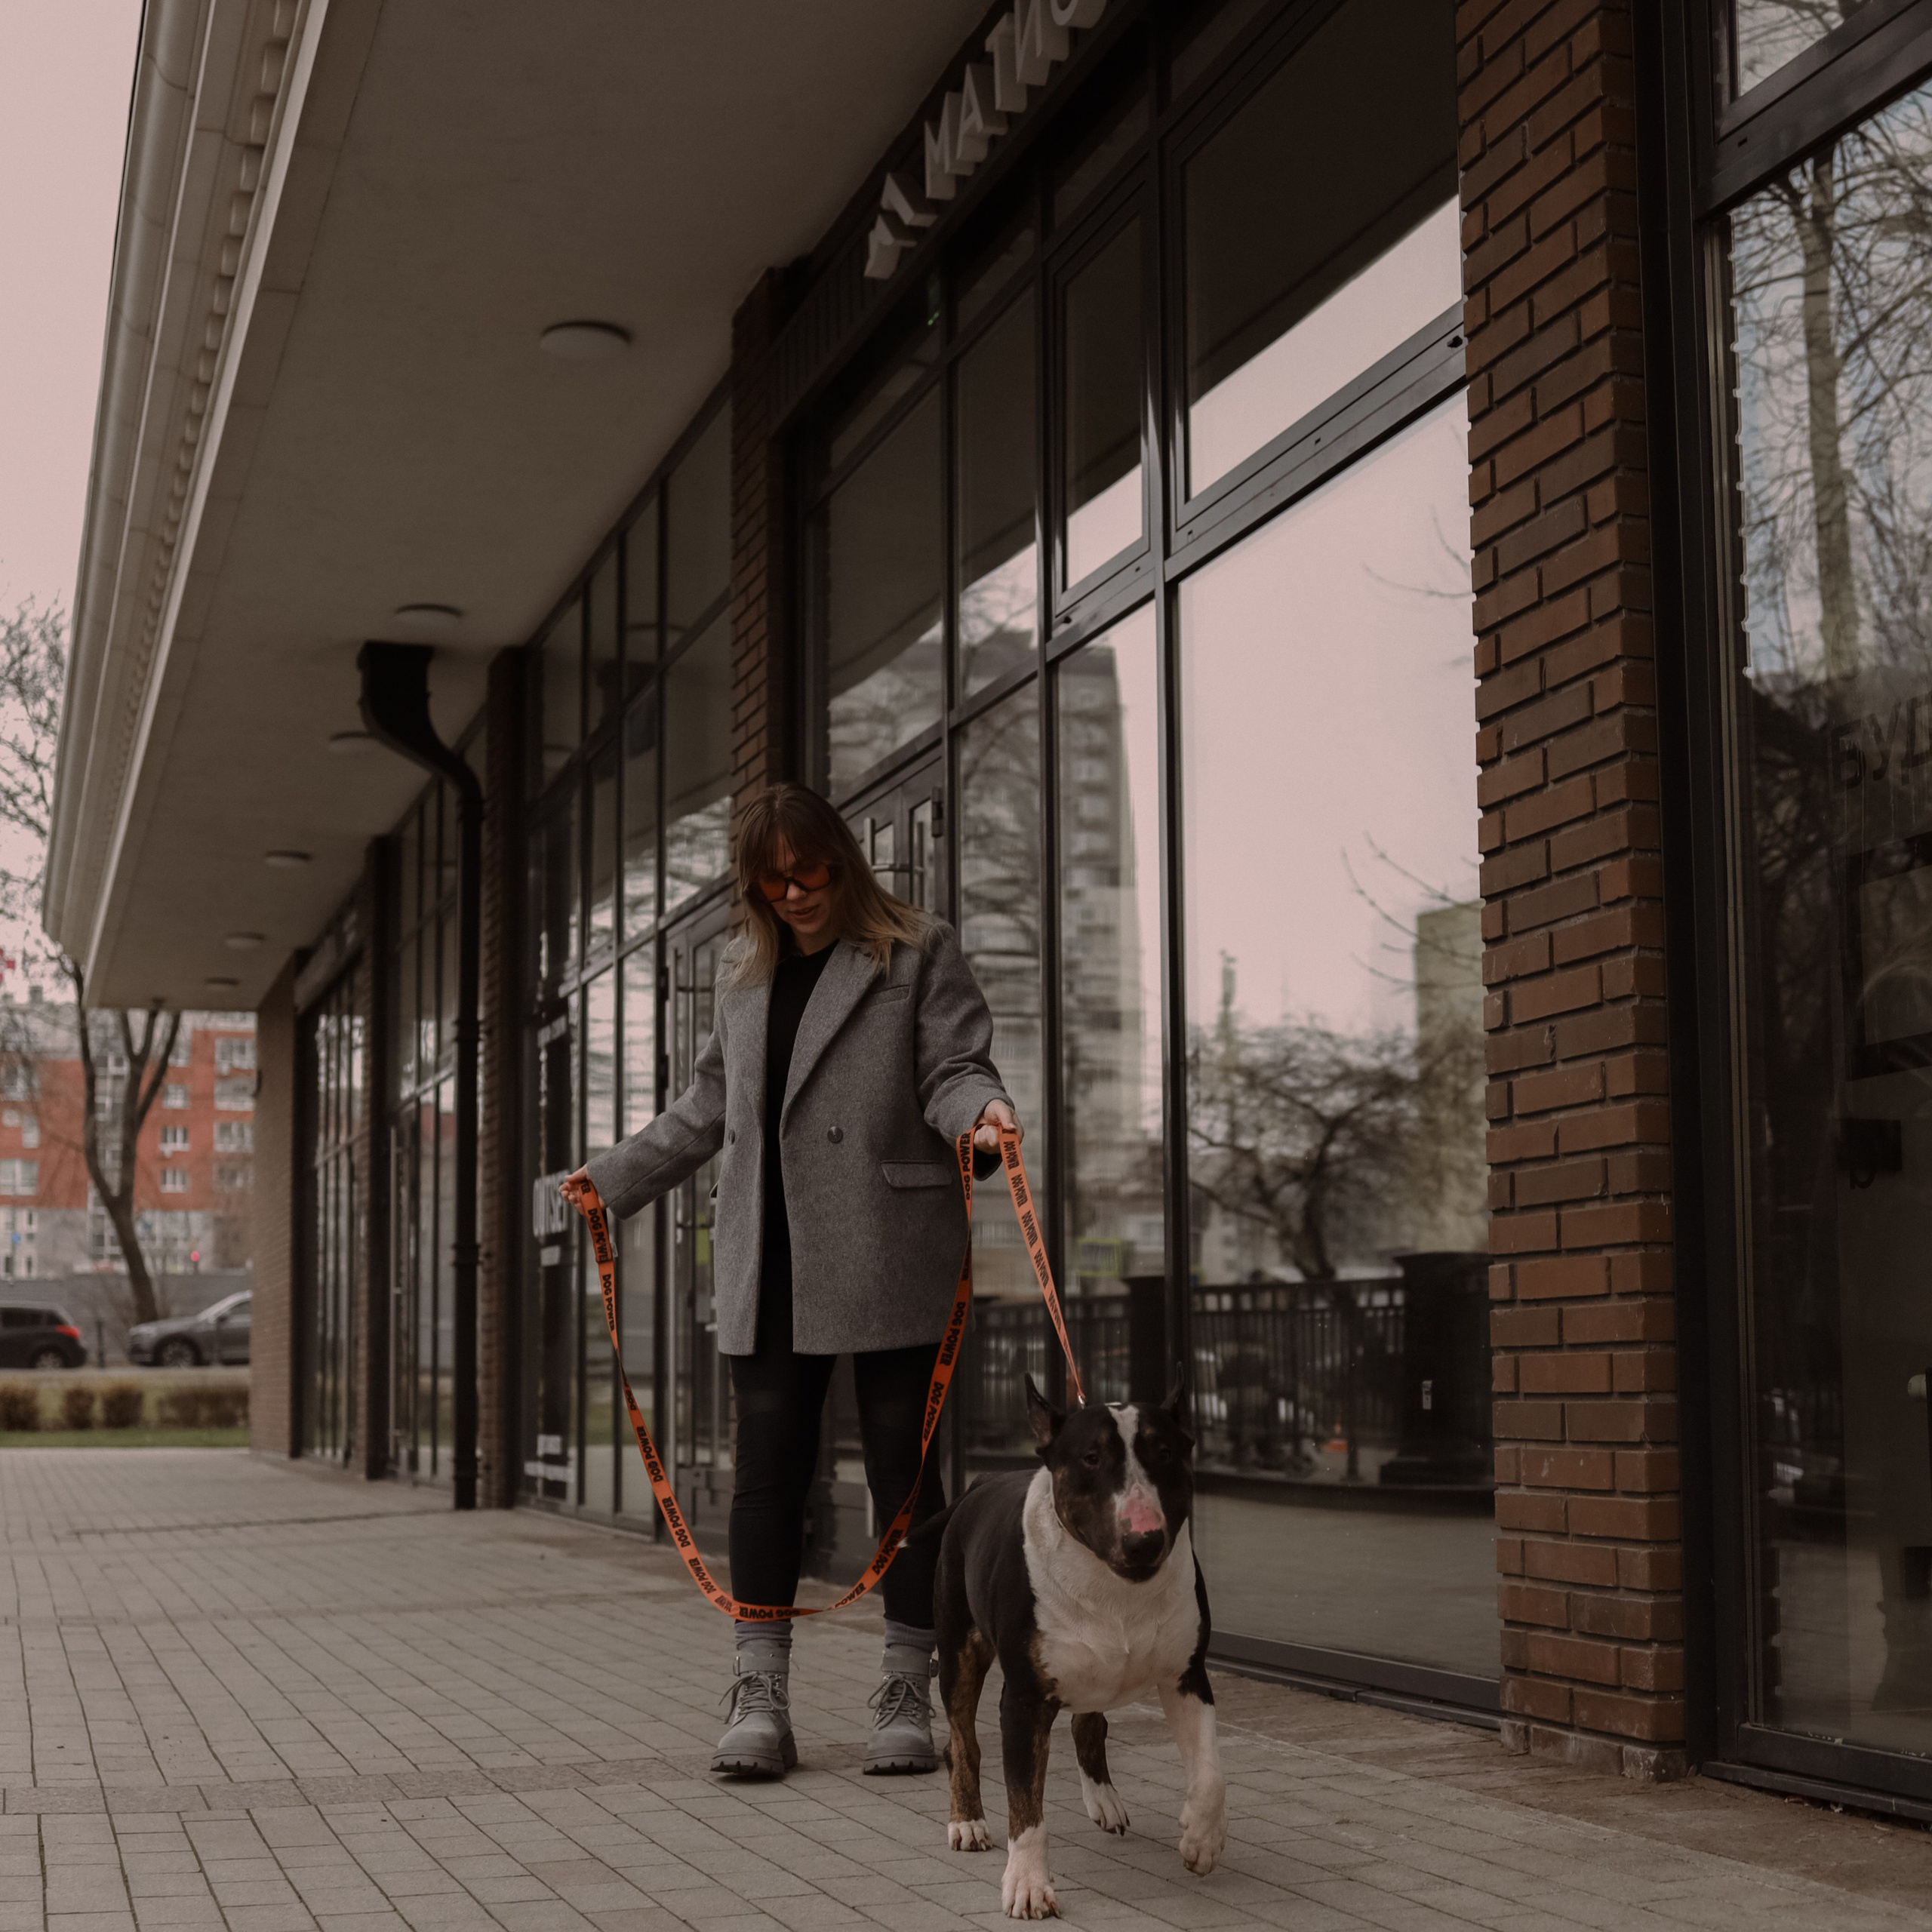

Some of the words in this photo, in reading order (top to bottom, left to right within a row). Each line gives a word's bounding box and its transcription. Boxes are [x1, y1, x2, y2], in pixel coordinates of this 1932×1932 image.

[960, 1132, 971, 1172] POWER
[588, 1208, 602, 1230] DOG
[594, 1231, 608, 1263] POWE
[602, 1273, 612, 1296] DOG
[605, 1297, 615, 1332] POWER
[952, 1302, 966, 1326] DOG
[940, 1327, 960, 1366] POWER
[930, 1381, 944, 1406] DOG
[923, 1405, 937, 1442] POWER
[636, 1426, 655, 1460] POWER
[648, 1461, 663, 1482] DOG
[662, 1497, 682, 1527] POWER
[675, 1527, 691, 1548] DOG
[688, 1557, 706, 1582] POWER
[701, 1580, 717, 1594] DOG
[872, 1554, 888, 1576] DOG
[835, 1582, 866, 1608] POWER
[739, 1606, 774, 1619] POWER
[776, 1609, 800, 1617] DOG
